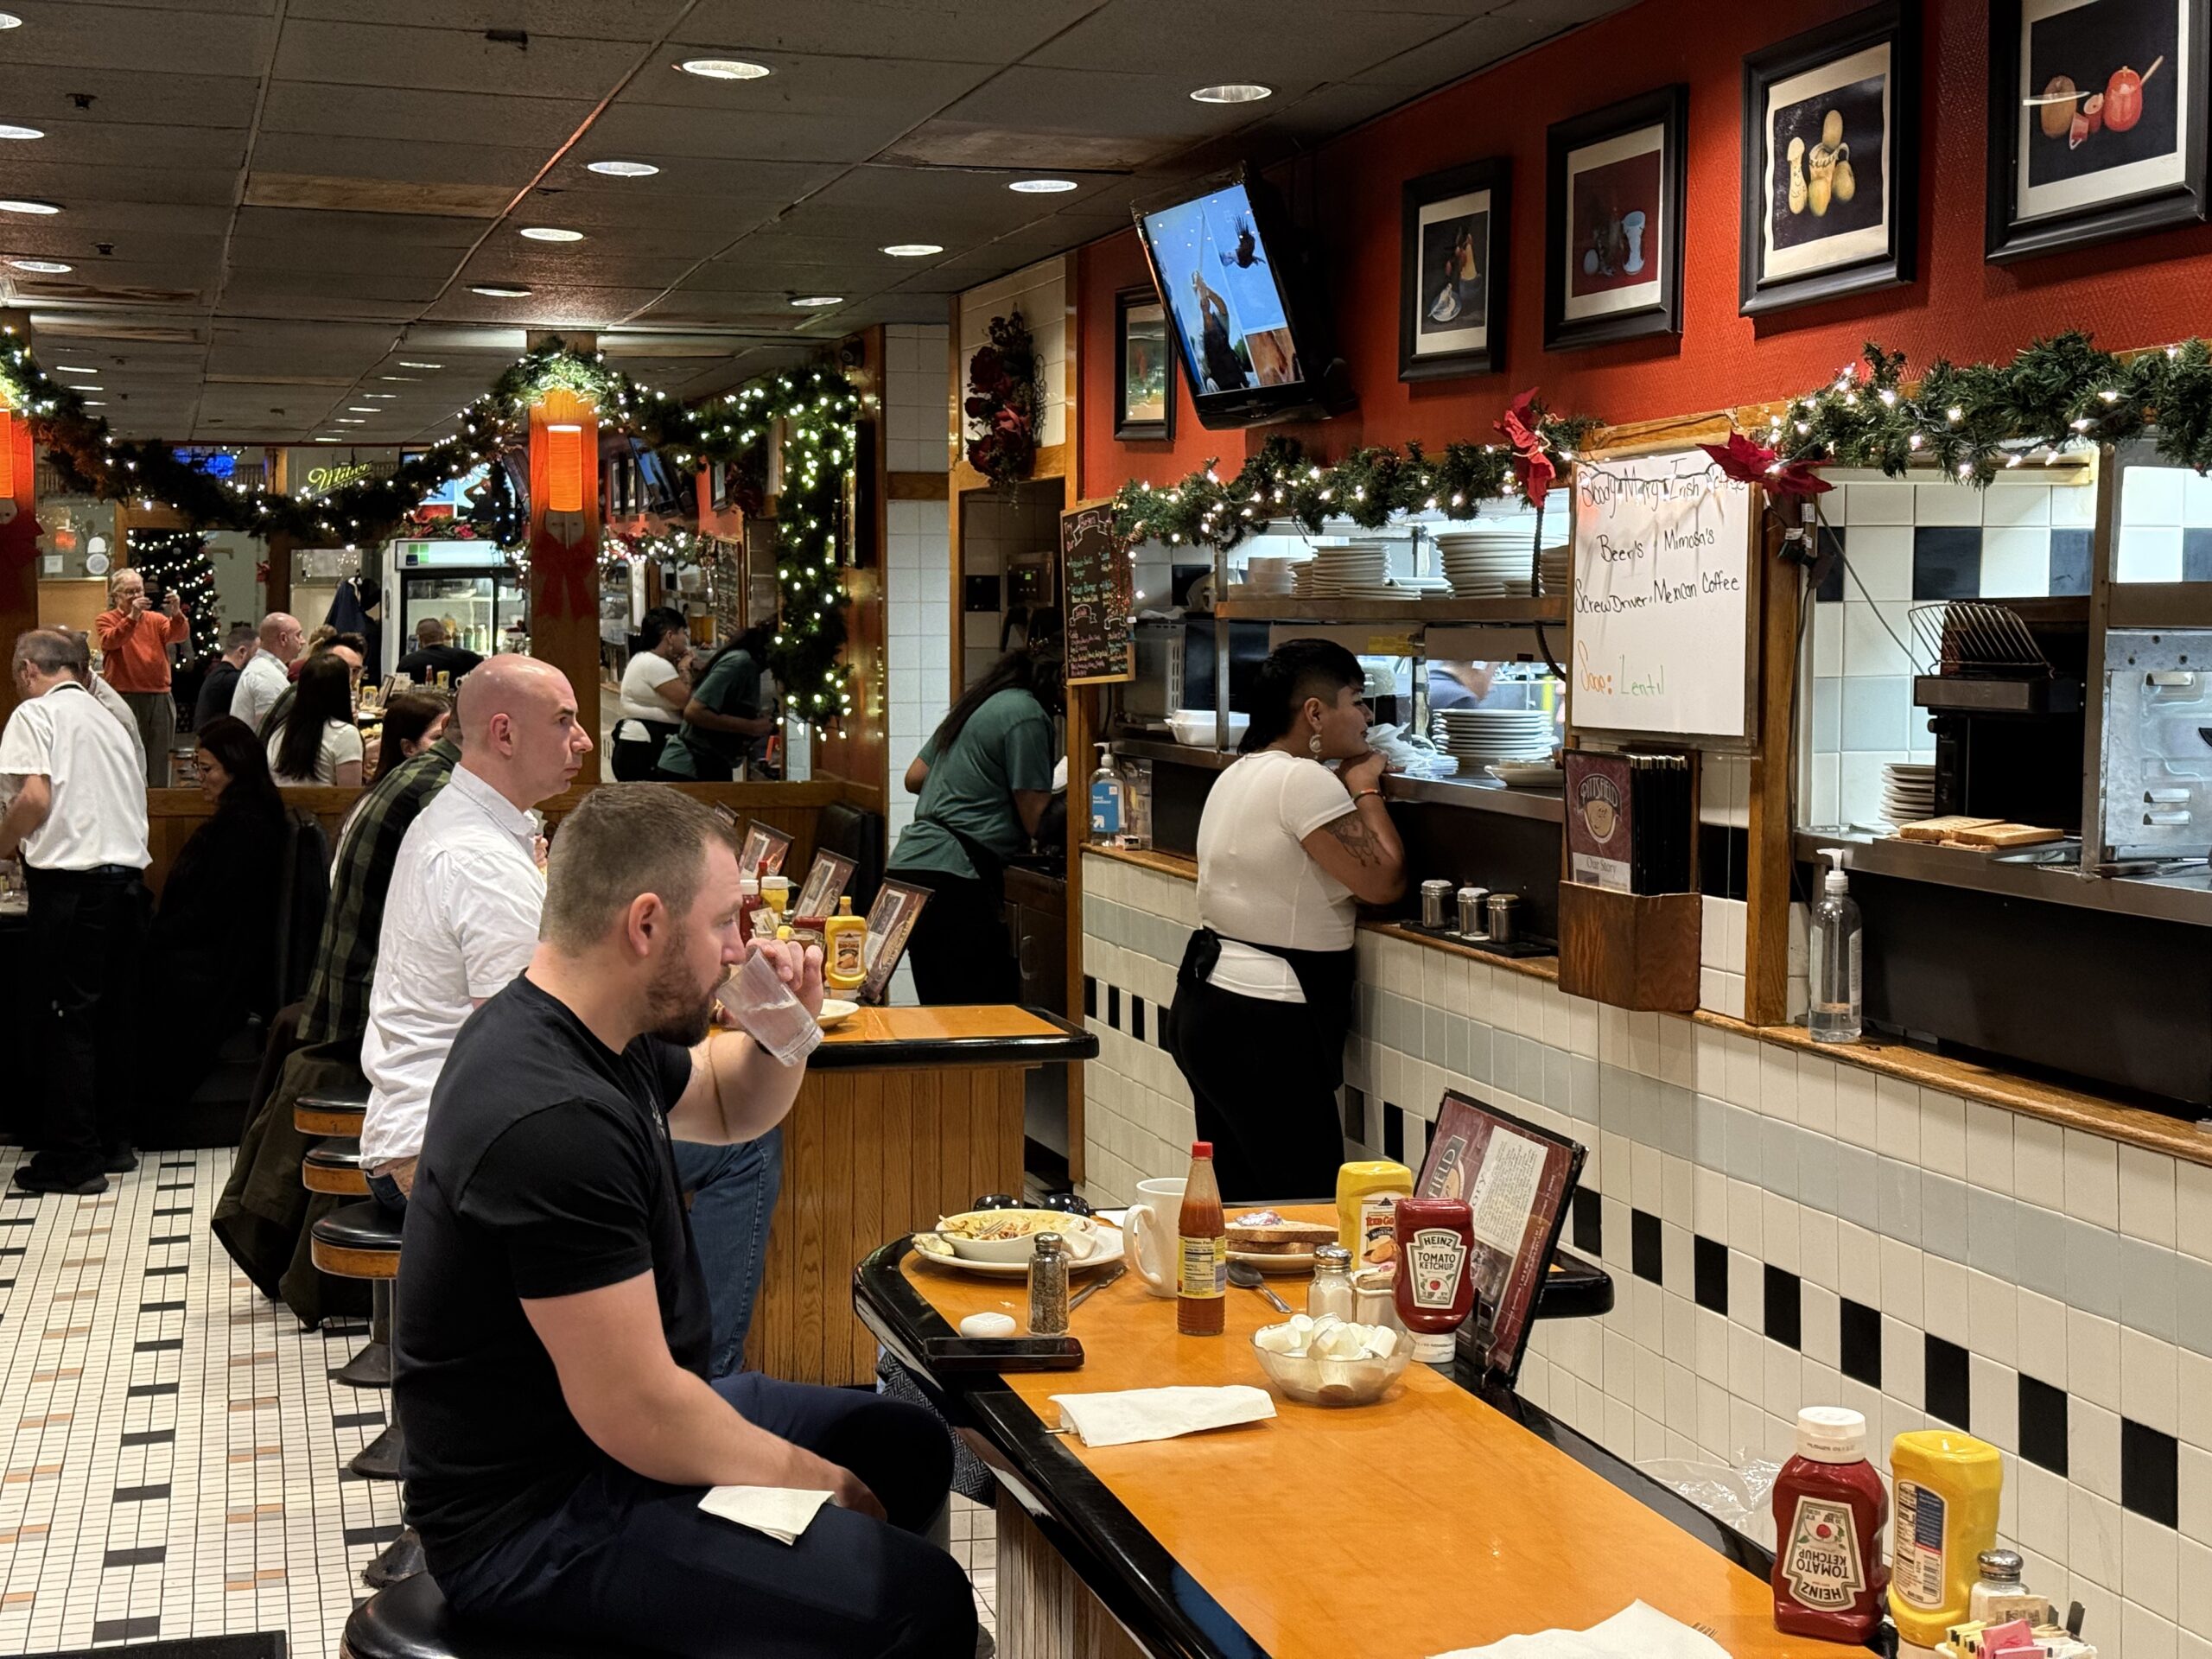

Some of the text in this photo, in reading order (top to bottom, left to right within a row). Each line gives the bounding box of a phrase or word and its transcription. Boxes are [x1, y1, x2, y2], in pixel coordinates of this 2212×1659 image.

[1596, 528, 1715, 563] Beer's Mimosa's
[1654, 578, 1697, 604] Mexican
[1701, 570, 1740, 594] Coffee
[1619, 653, 1664, 696] Lentil
[1580, 777, 1618, 807] PITTSFIELD
[1471, 1173, 1486, 1206] ory
[1382, 1216, 1395, 1225] GO
[1423, 1236, 1453, 1247] HEINZ
[1417, 1251, 1456, 1263] TOMATO
[1419, 1262, 1454, 1271] KETCHUP
[1798, 1548, 1847, 1566] KETCHUP
[1796, 1558, 1849, 1579] TOMATO
[1801, 1581, 1842, 1600] HEINZ
